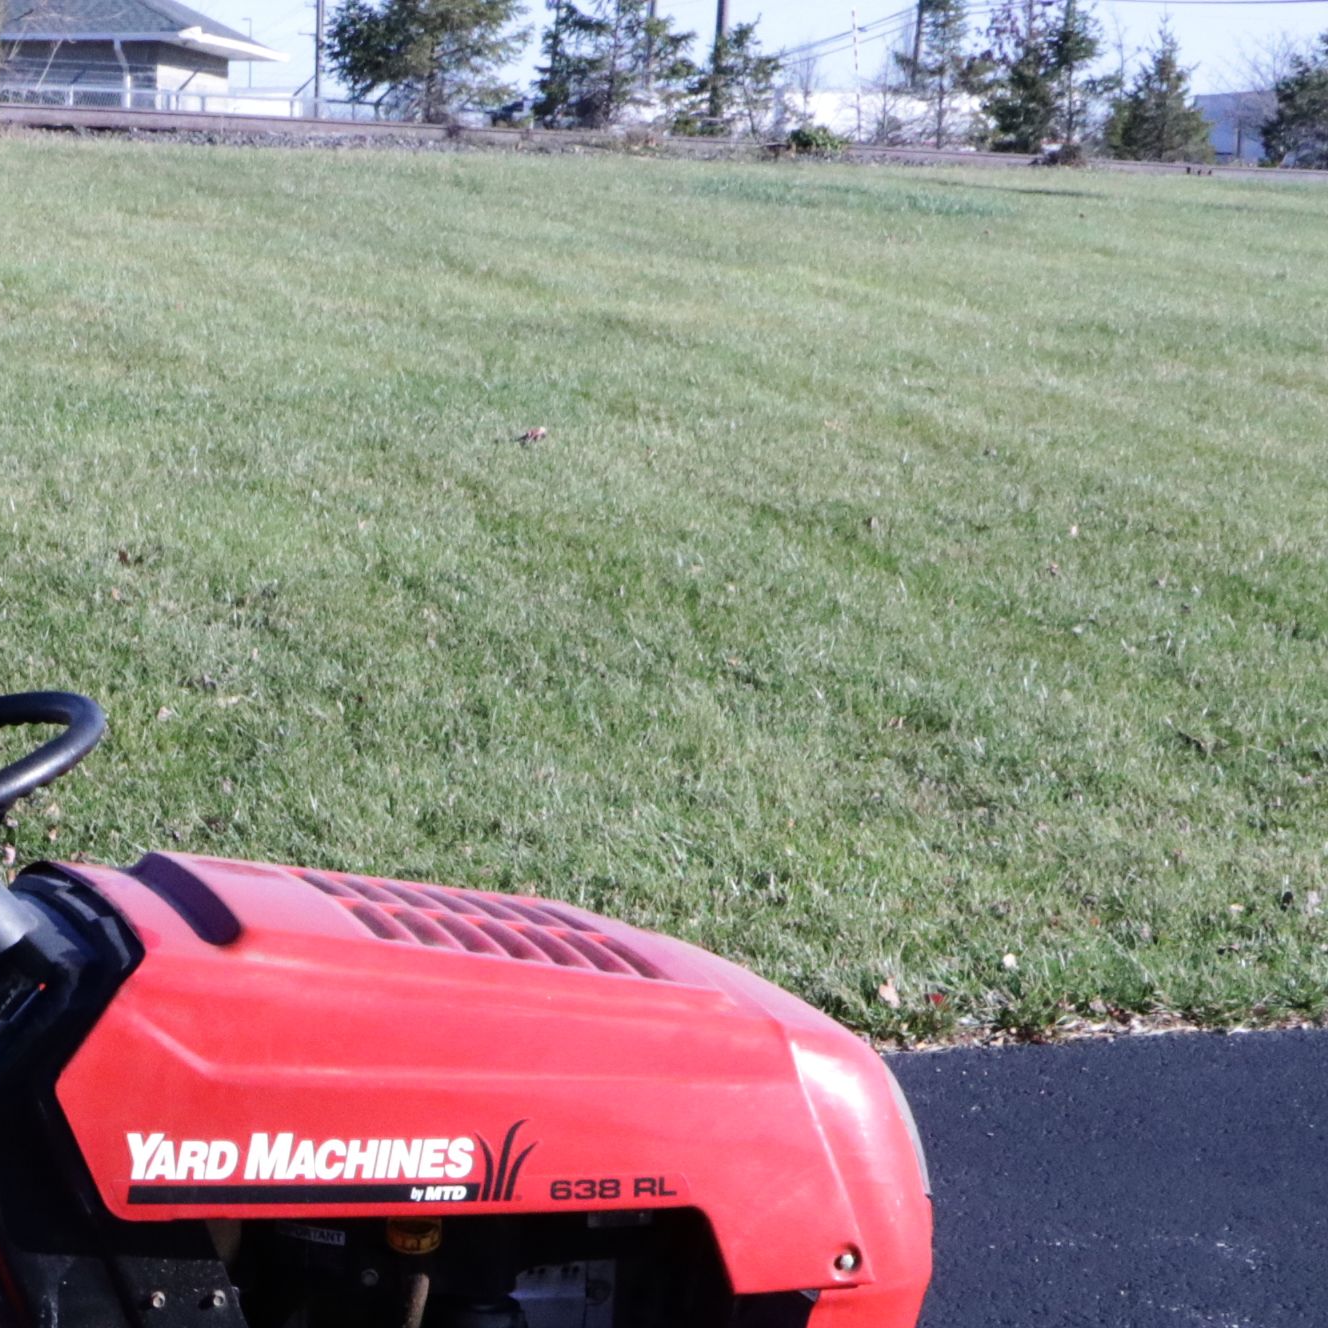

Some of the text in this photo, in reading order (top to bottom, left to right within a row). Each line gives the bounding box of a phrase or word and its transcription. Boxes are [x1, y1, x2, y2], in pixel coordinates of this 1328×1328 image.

[126, 1132, 475, 1180] YARD MACHINES
[410, 1186, 468, 1202] by MTD
[550, 1177, 677, 1200] 638 RL
